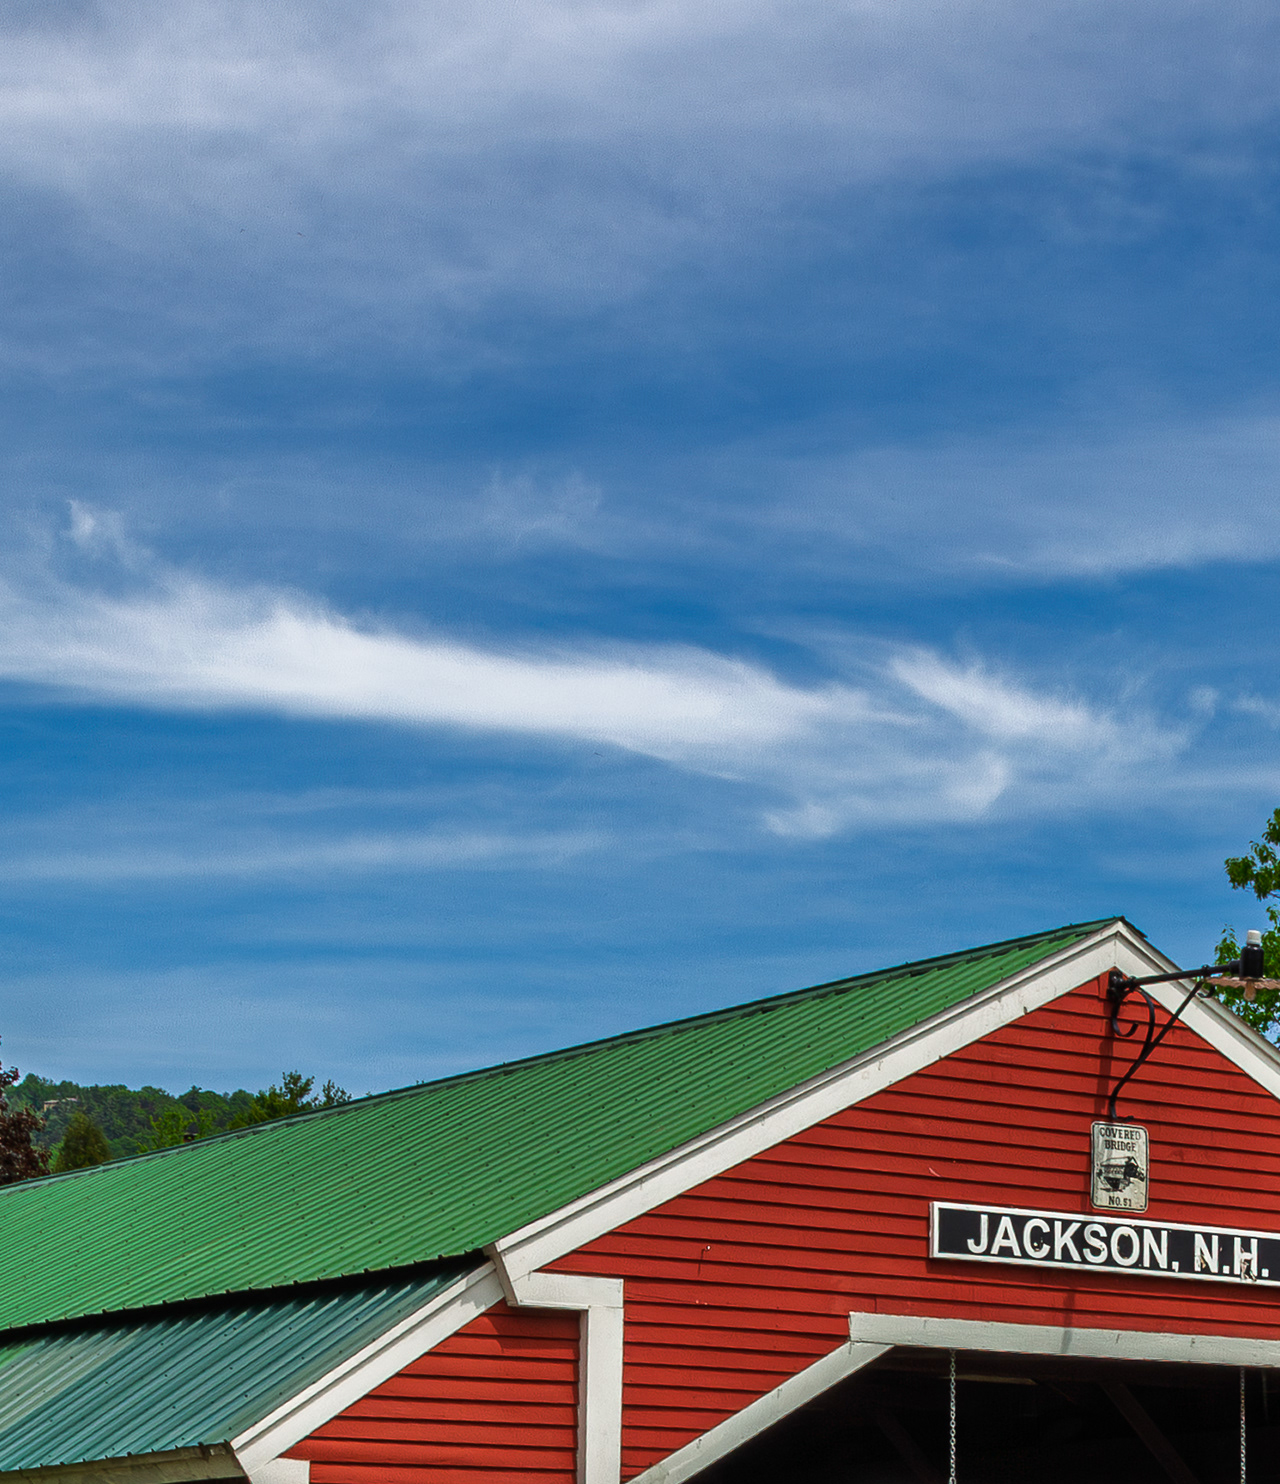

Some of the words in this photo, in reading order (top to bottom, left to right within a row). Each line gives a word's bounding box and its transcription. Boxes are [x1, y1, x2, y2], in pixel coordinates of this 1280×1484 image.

[1100, 1127, 1141, 1140] COVERED
[1104, 1140, 1136, 1152] BRIDGE
[967, 1214, 1179, 1272] JACKSON,
[1194, 1233, 1269, 1278] N.H.
